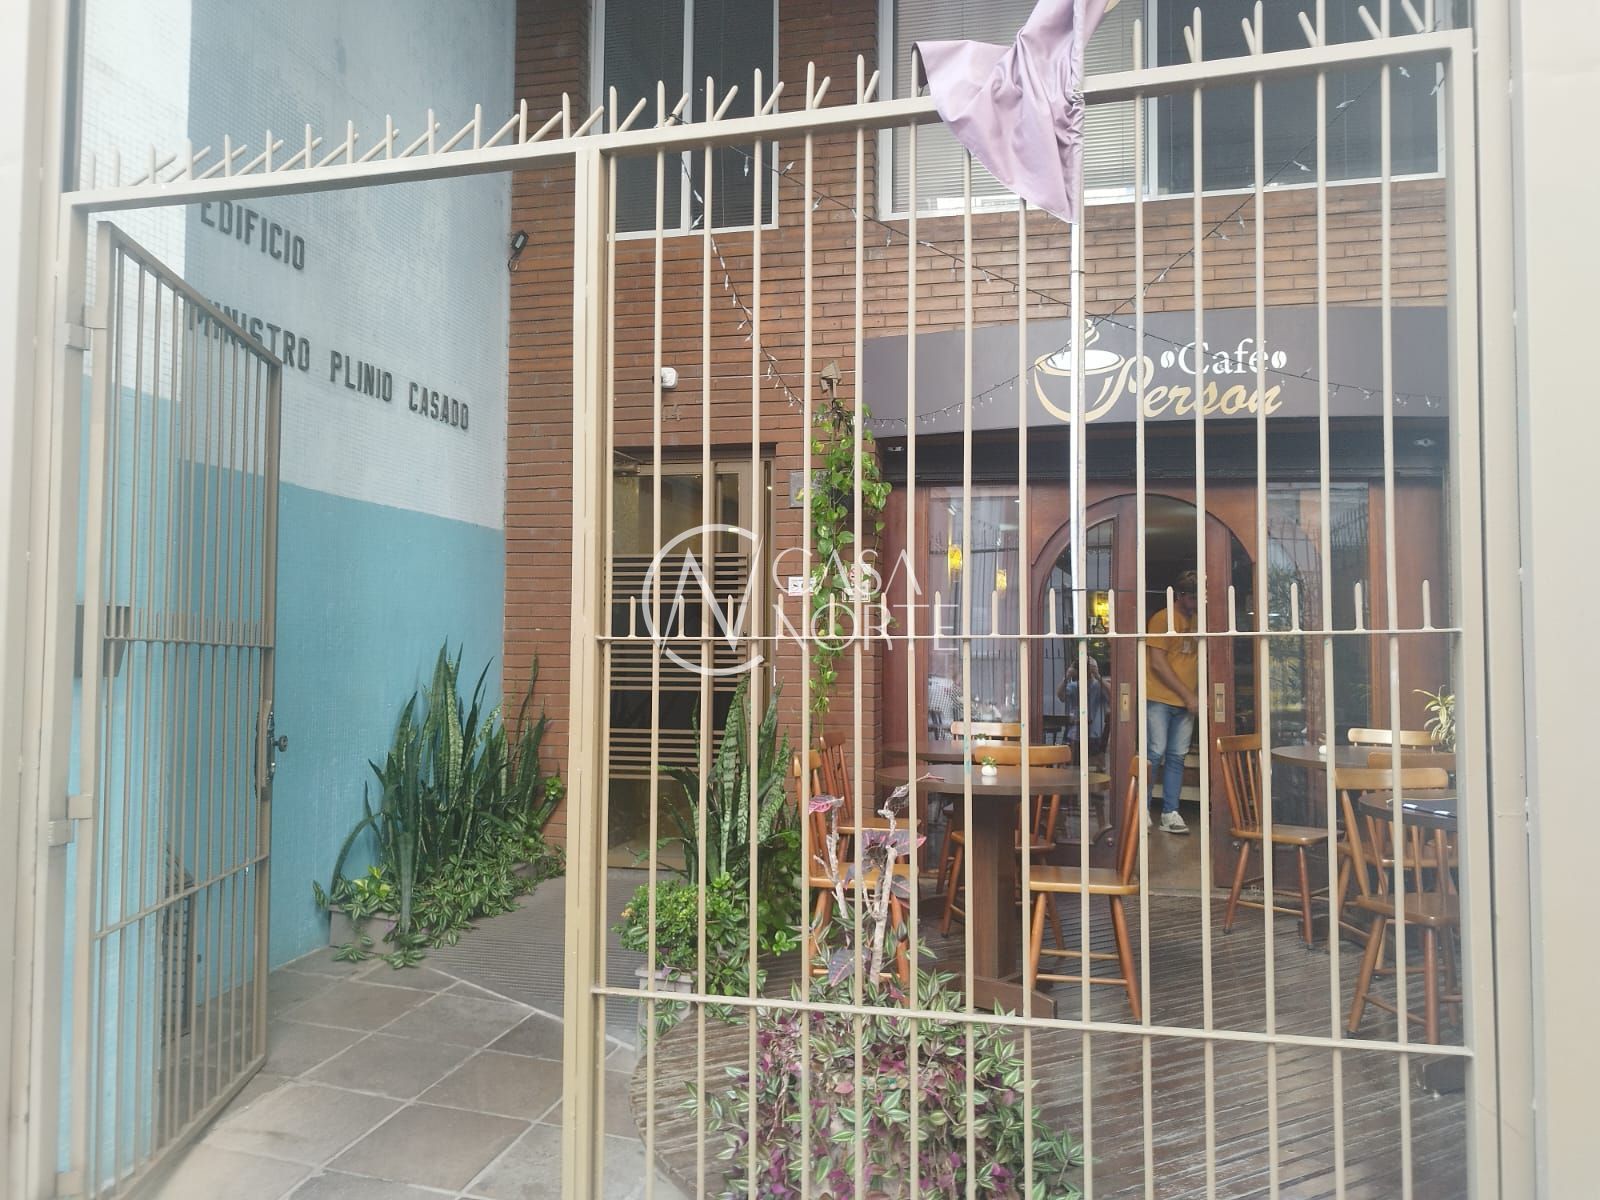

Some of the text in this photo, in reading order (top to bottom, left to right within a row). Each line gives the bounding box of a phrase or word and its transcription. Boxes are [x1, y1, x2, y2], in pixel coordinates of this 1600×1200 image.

[201, 201, 305, 271] EDIFICIO
[330, 350, 393, 402] PLINIO
[409, 381, 470, 430] CASADO
[1116, 355, 1283, 417] Person
[1178, 338, 1269, 376] Café
